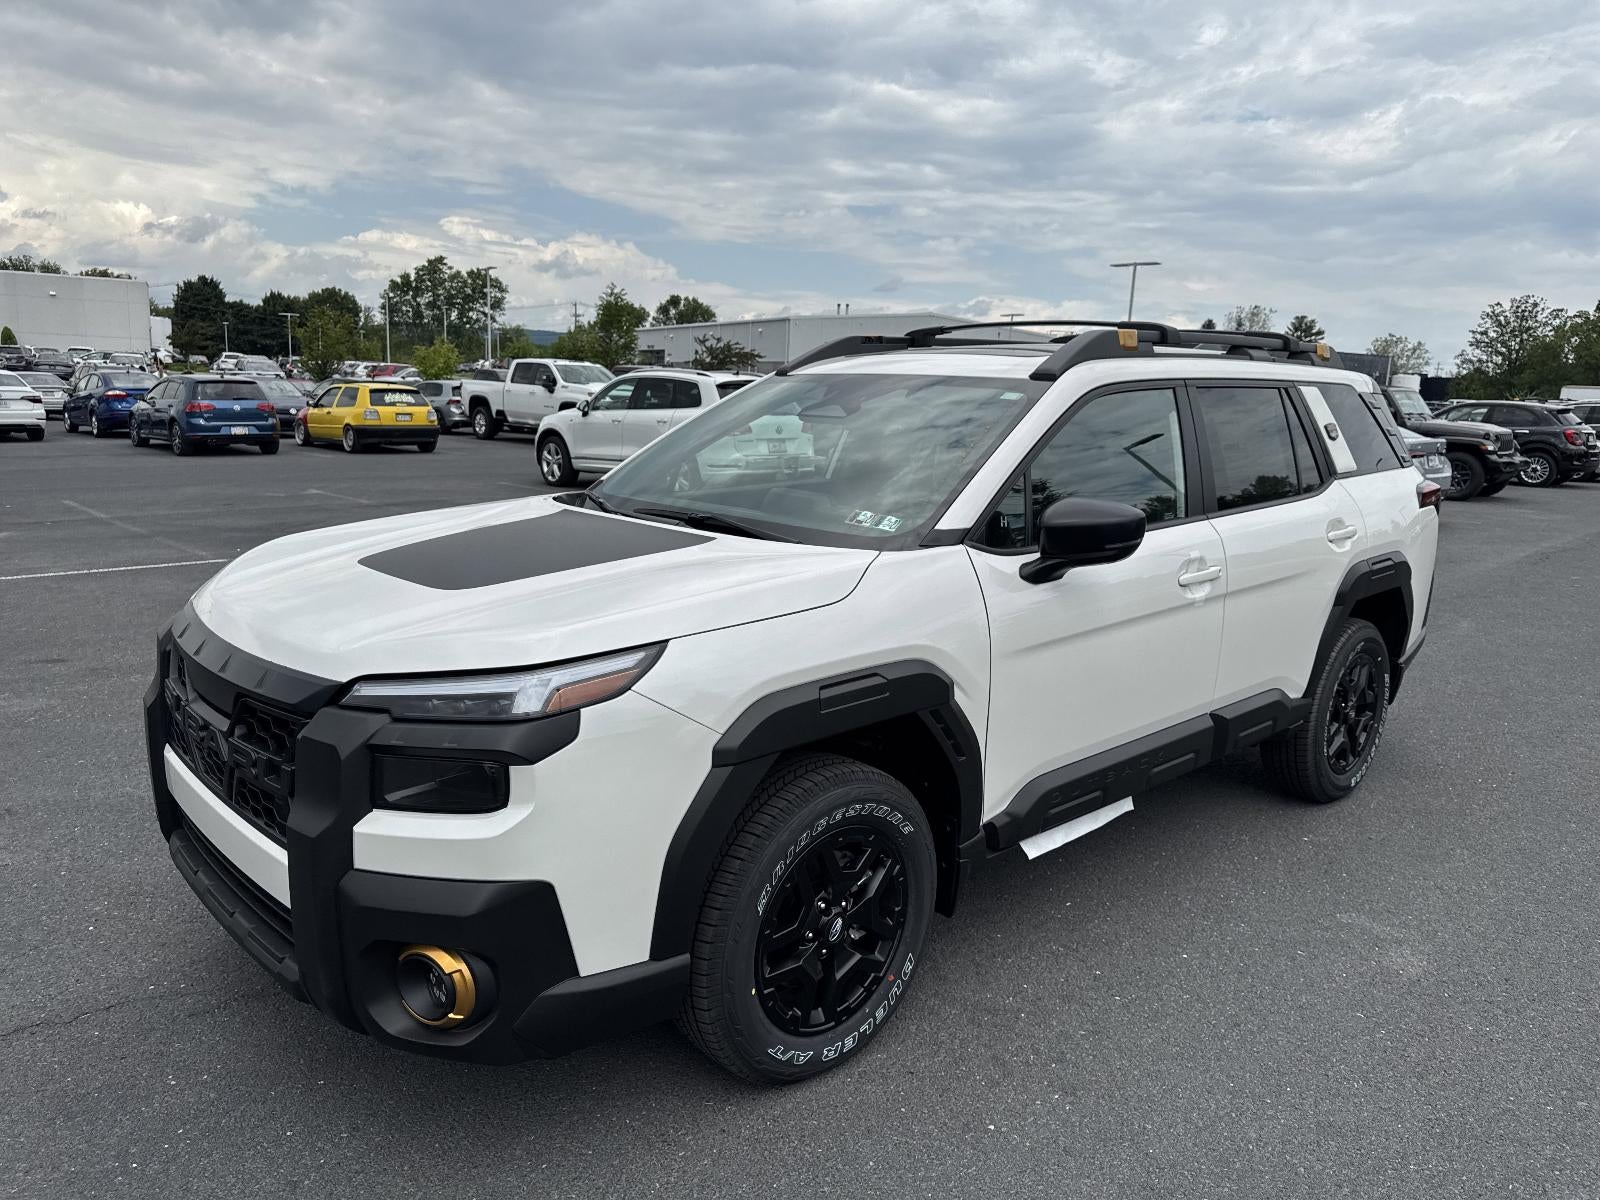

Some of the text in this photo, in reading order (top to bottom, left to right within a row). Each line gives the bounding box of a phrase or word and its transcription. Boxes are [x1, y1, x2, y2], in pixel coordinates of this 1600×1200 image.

[757, 803, 915, 916] BRIDGESTONE
[768, 952, 915, 1065] DUELER A/T
